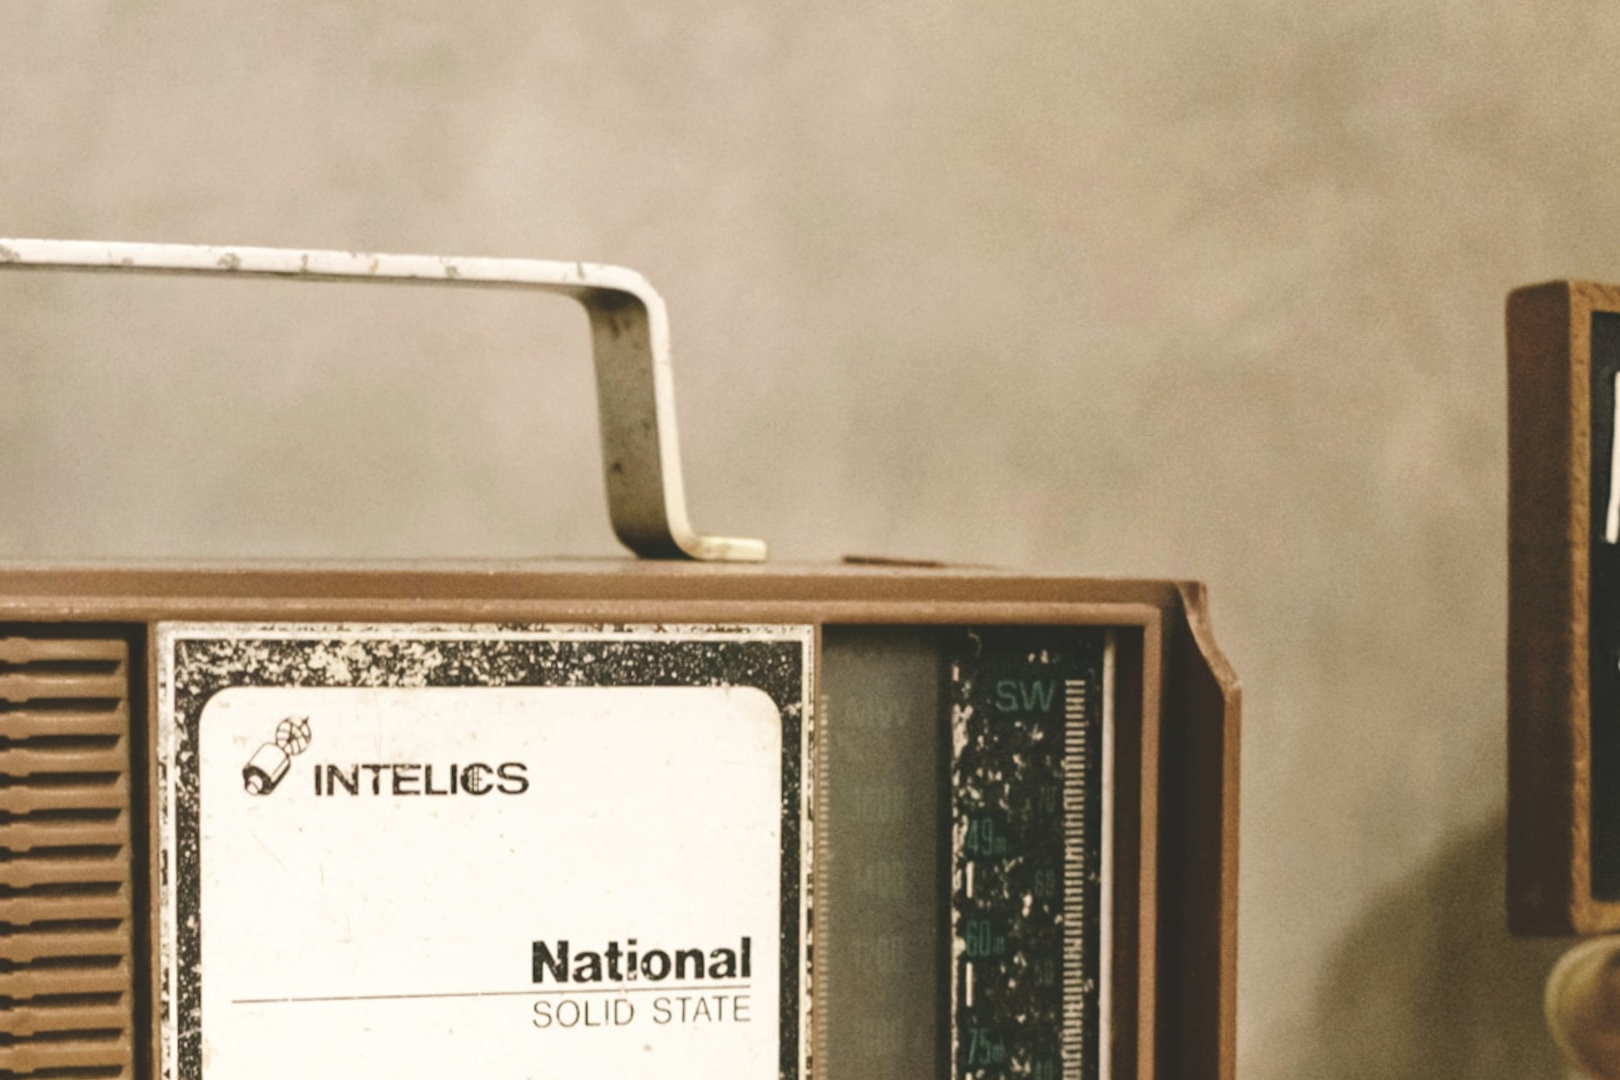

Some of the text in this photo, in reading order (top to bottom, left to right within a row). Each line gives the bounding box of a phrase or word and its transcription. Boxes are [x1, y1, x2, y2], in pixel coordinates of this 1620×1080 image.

[995, 679, 1056, 712] SW
[314, 762, 530, 796] INTELICS
[532, 936, 751, 983] National
[533, 995, 751, 1028] SOLID STATE
